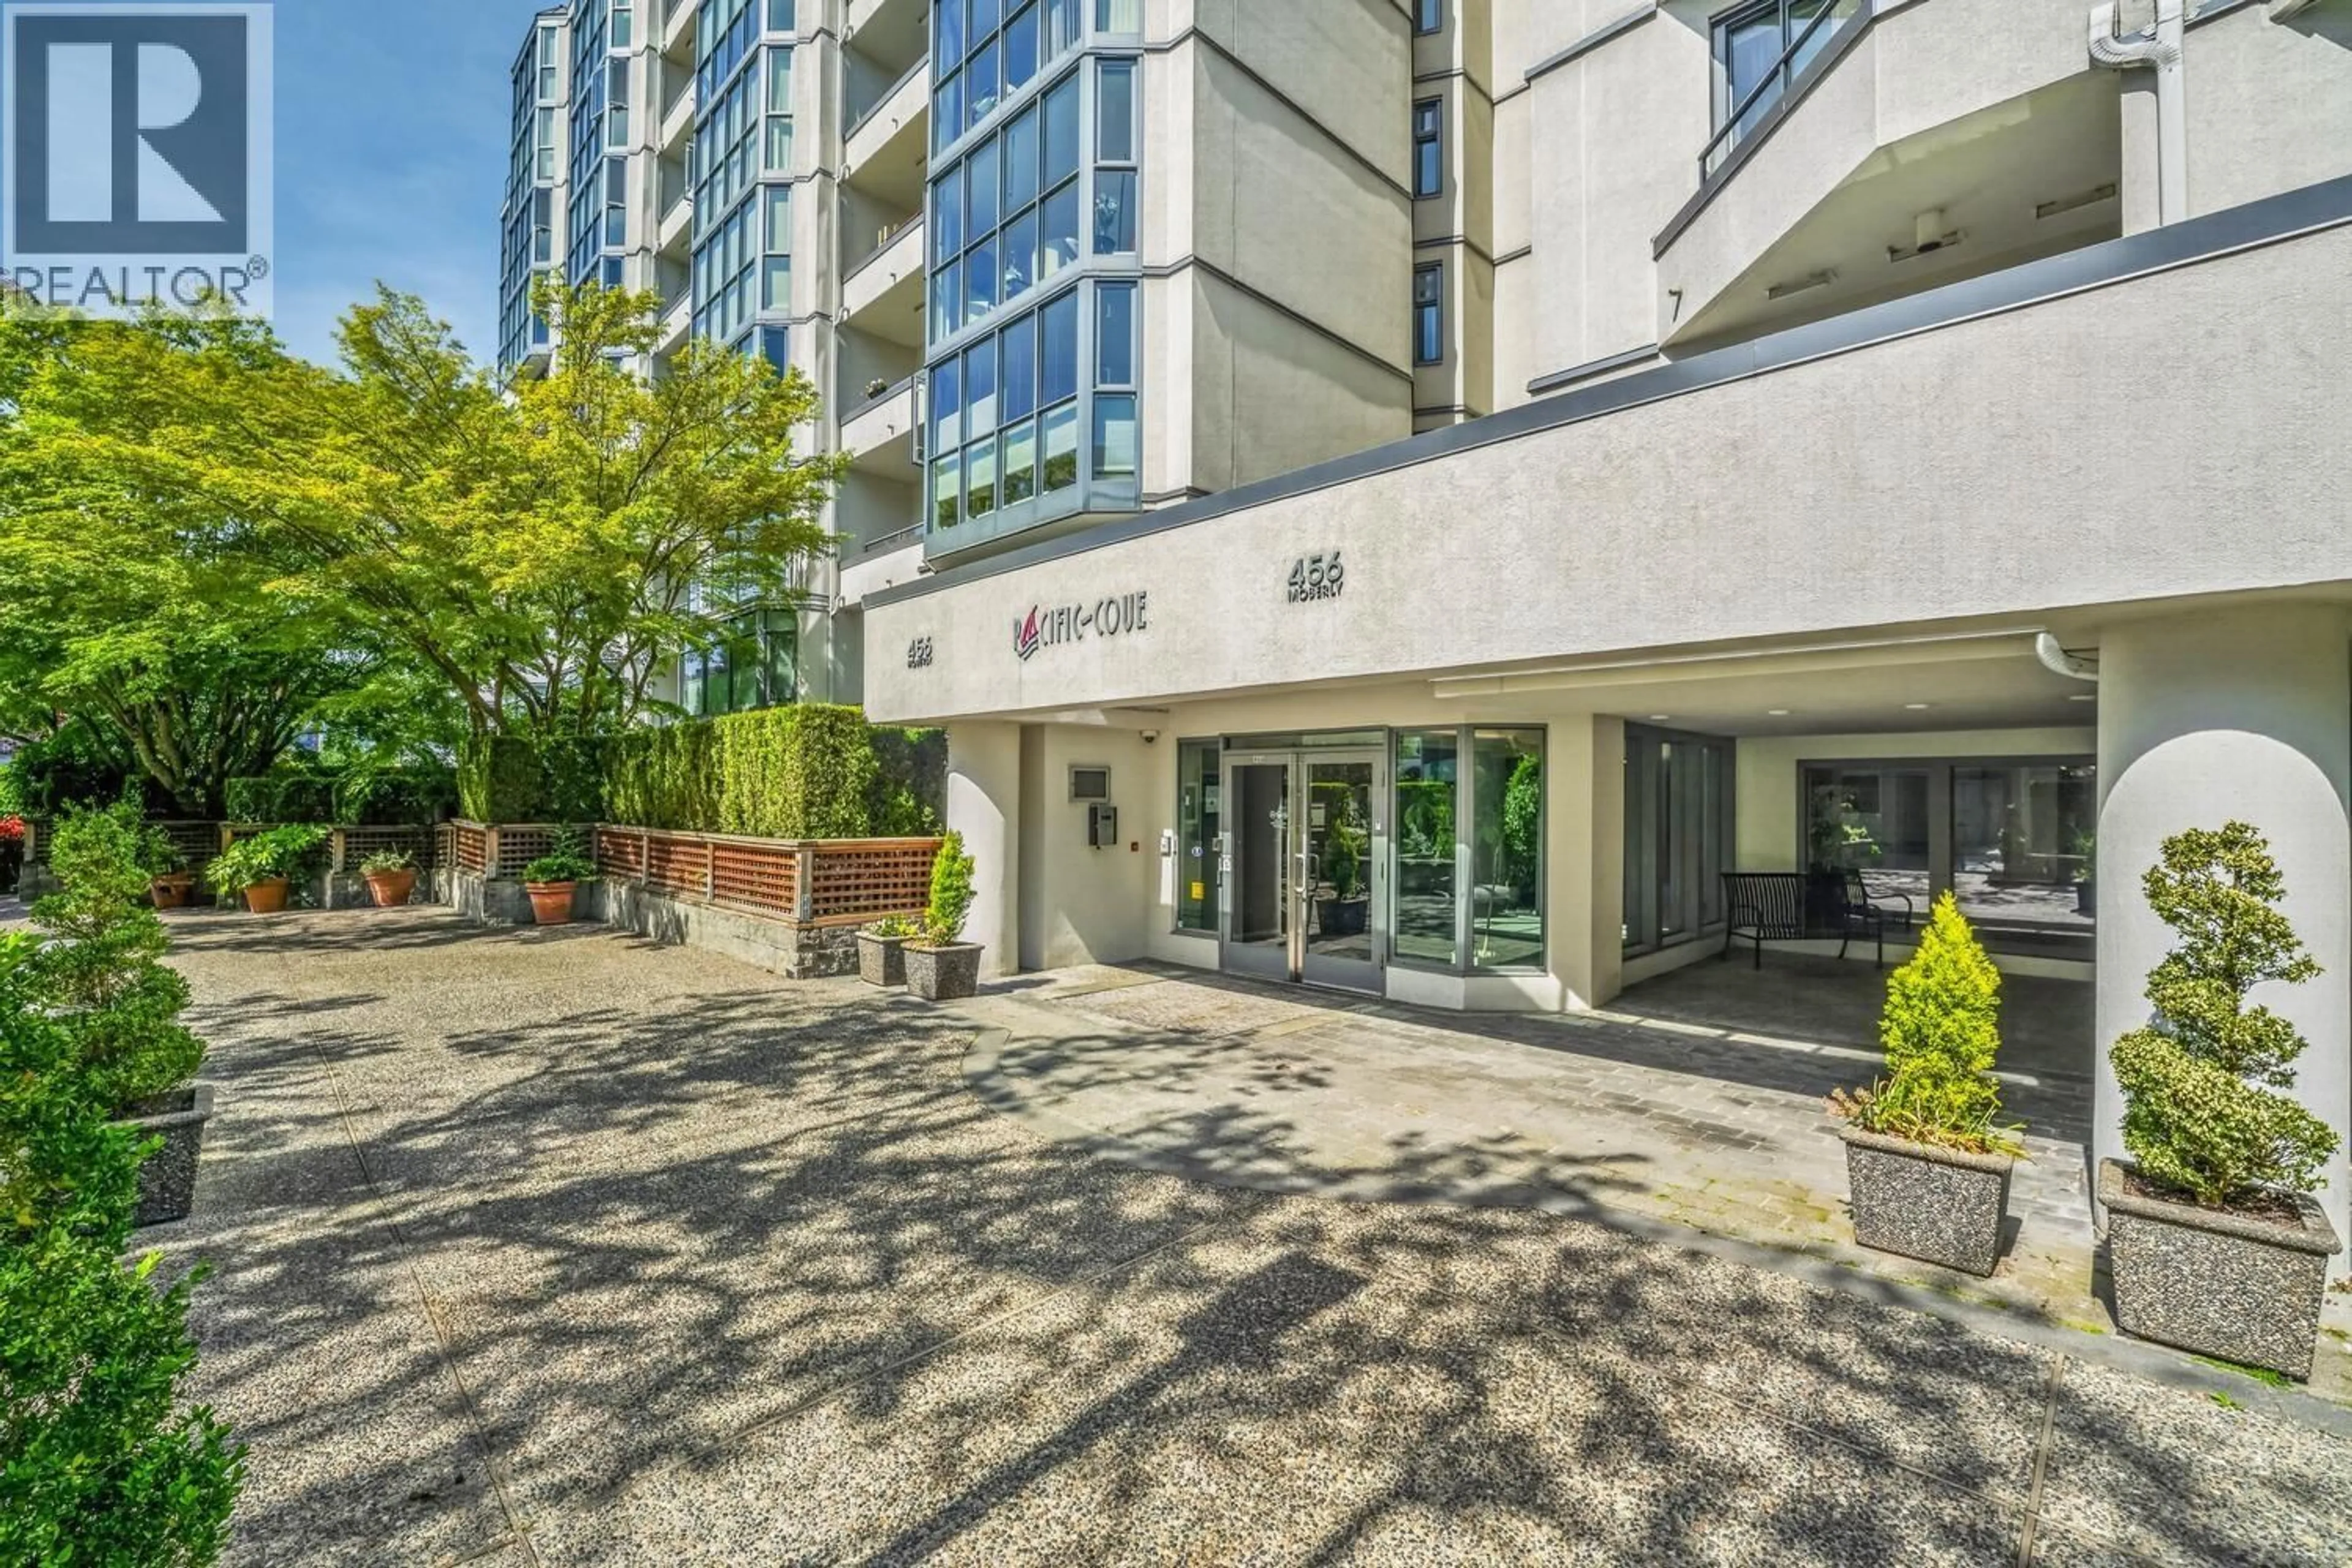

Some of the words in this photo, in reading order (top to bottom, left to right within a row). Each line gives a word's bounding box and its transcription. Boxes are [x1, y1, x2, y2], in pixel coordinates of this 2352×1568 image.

[1288, 551, 1343, 588] 456
[1287, 582, 1343, 603] MOBERLY
[908, 636, 933, 660] 456
